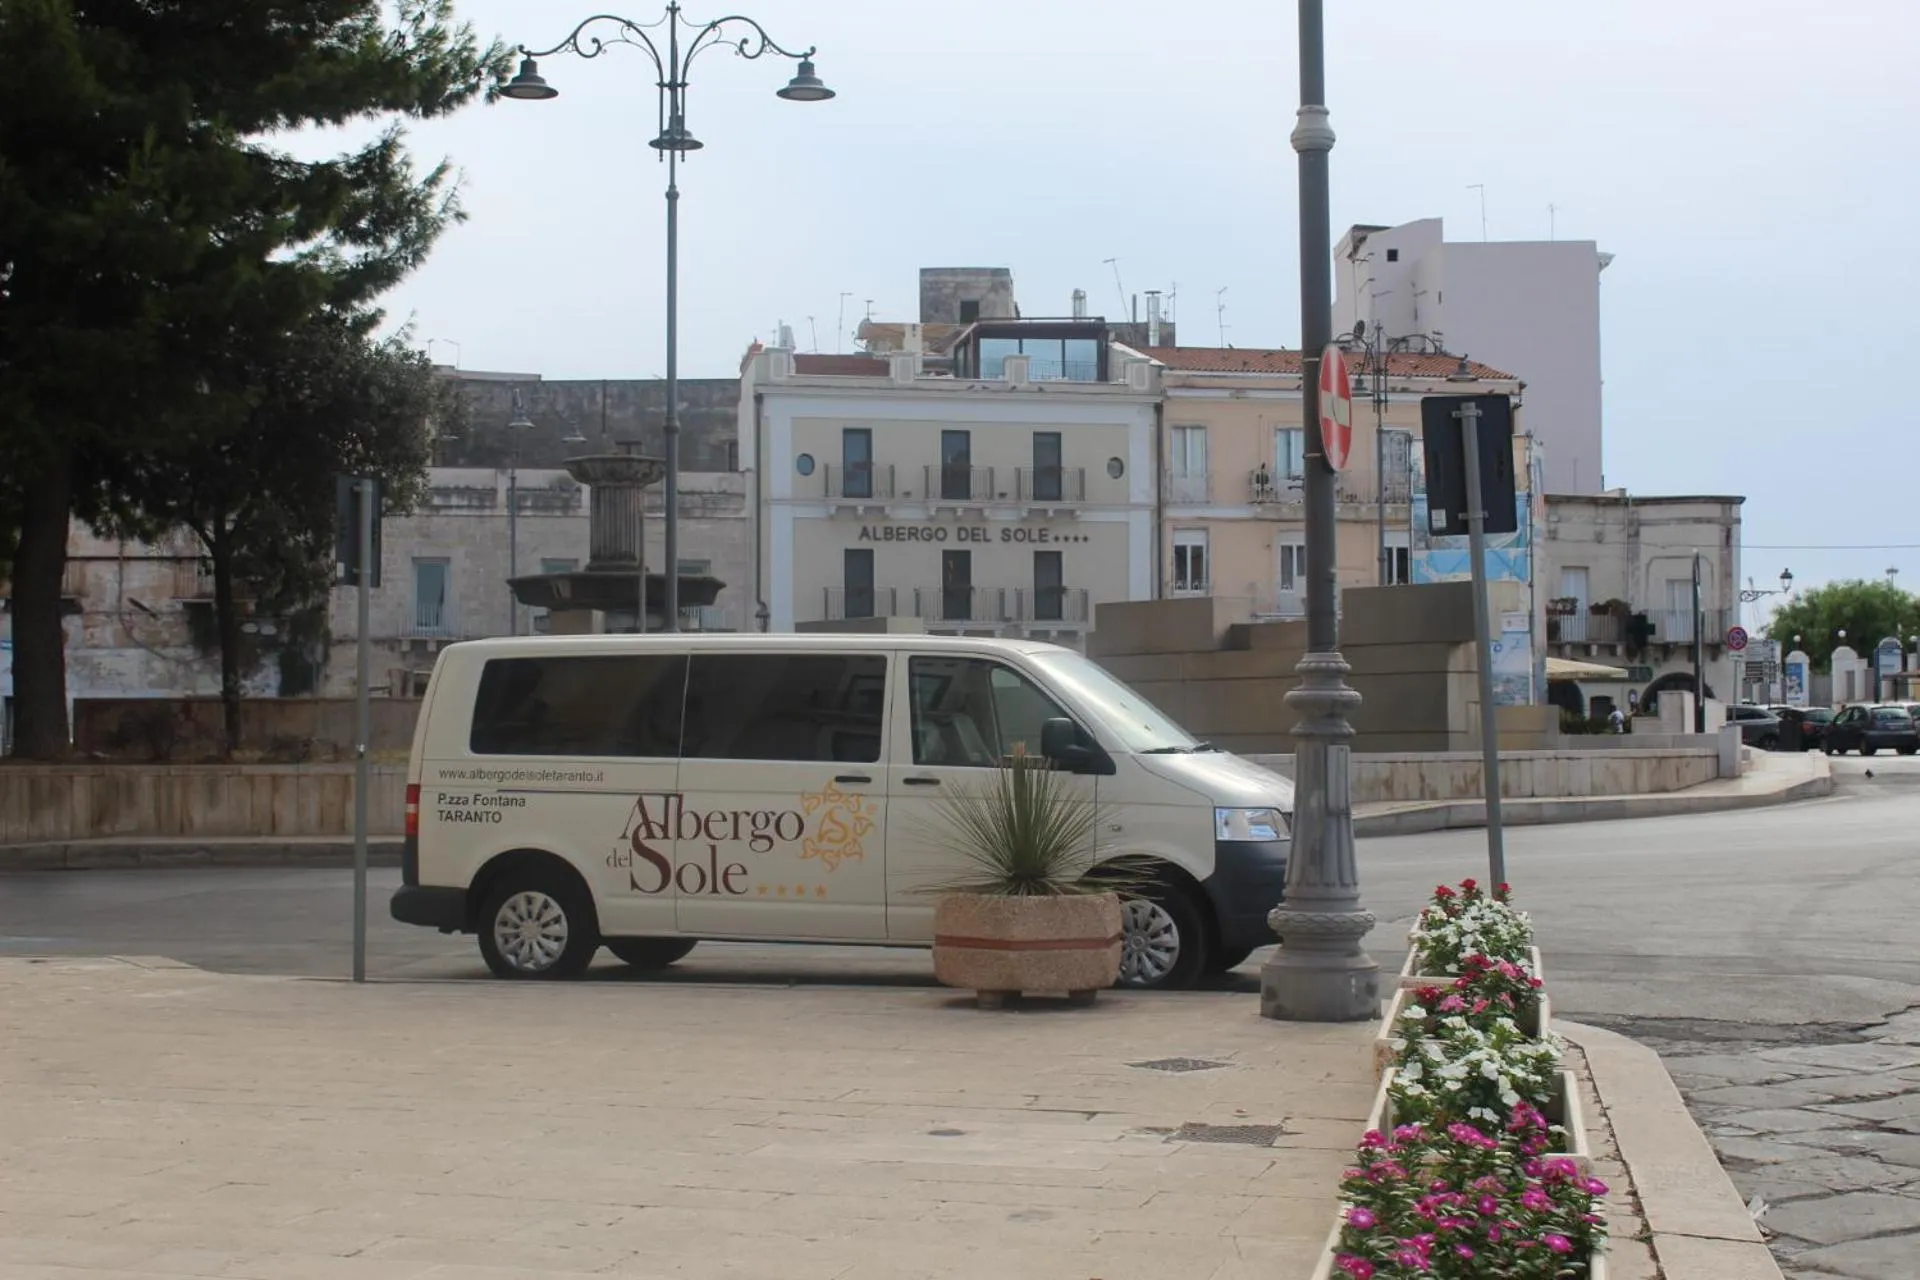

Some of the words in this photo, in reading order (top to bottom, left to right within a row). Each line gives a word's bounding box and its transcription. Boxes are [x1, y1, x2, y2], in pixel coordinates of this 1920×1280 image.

[858, 526, 948, 542] ALBERGO
[957, 527, 992, 543] DEL
[1001, 528, 1049, 543] SOLE
[439, 768, 604, 782] www.albergodelsoletaranto.it
[438, 793, 469, 806] P.zza
[473, 794, 526, 808] Fontana
[438, 810, 503, 823] TARANTO
[619, 793, 805, 853] Albergo
[606, 848, 632, 868] del
[630, 821, 749, 895] Sole
